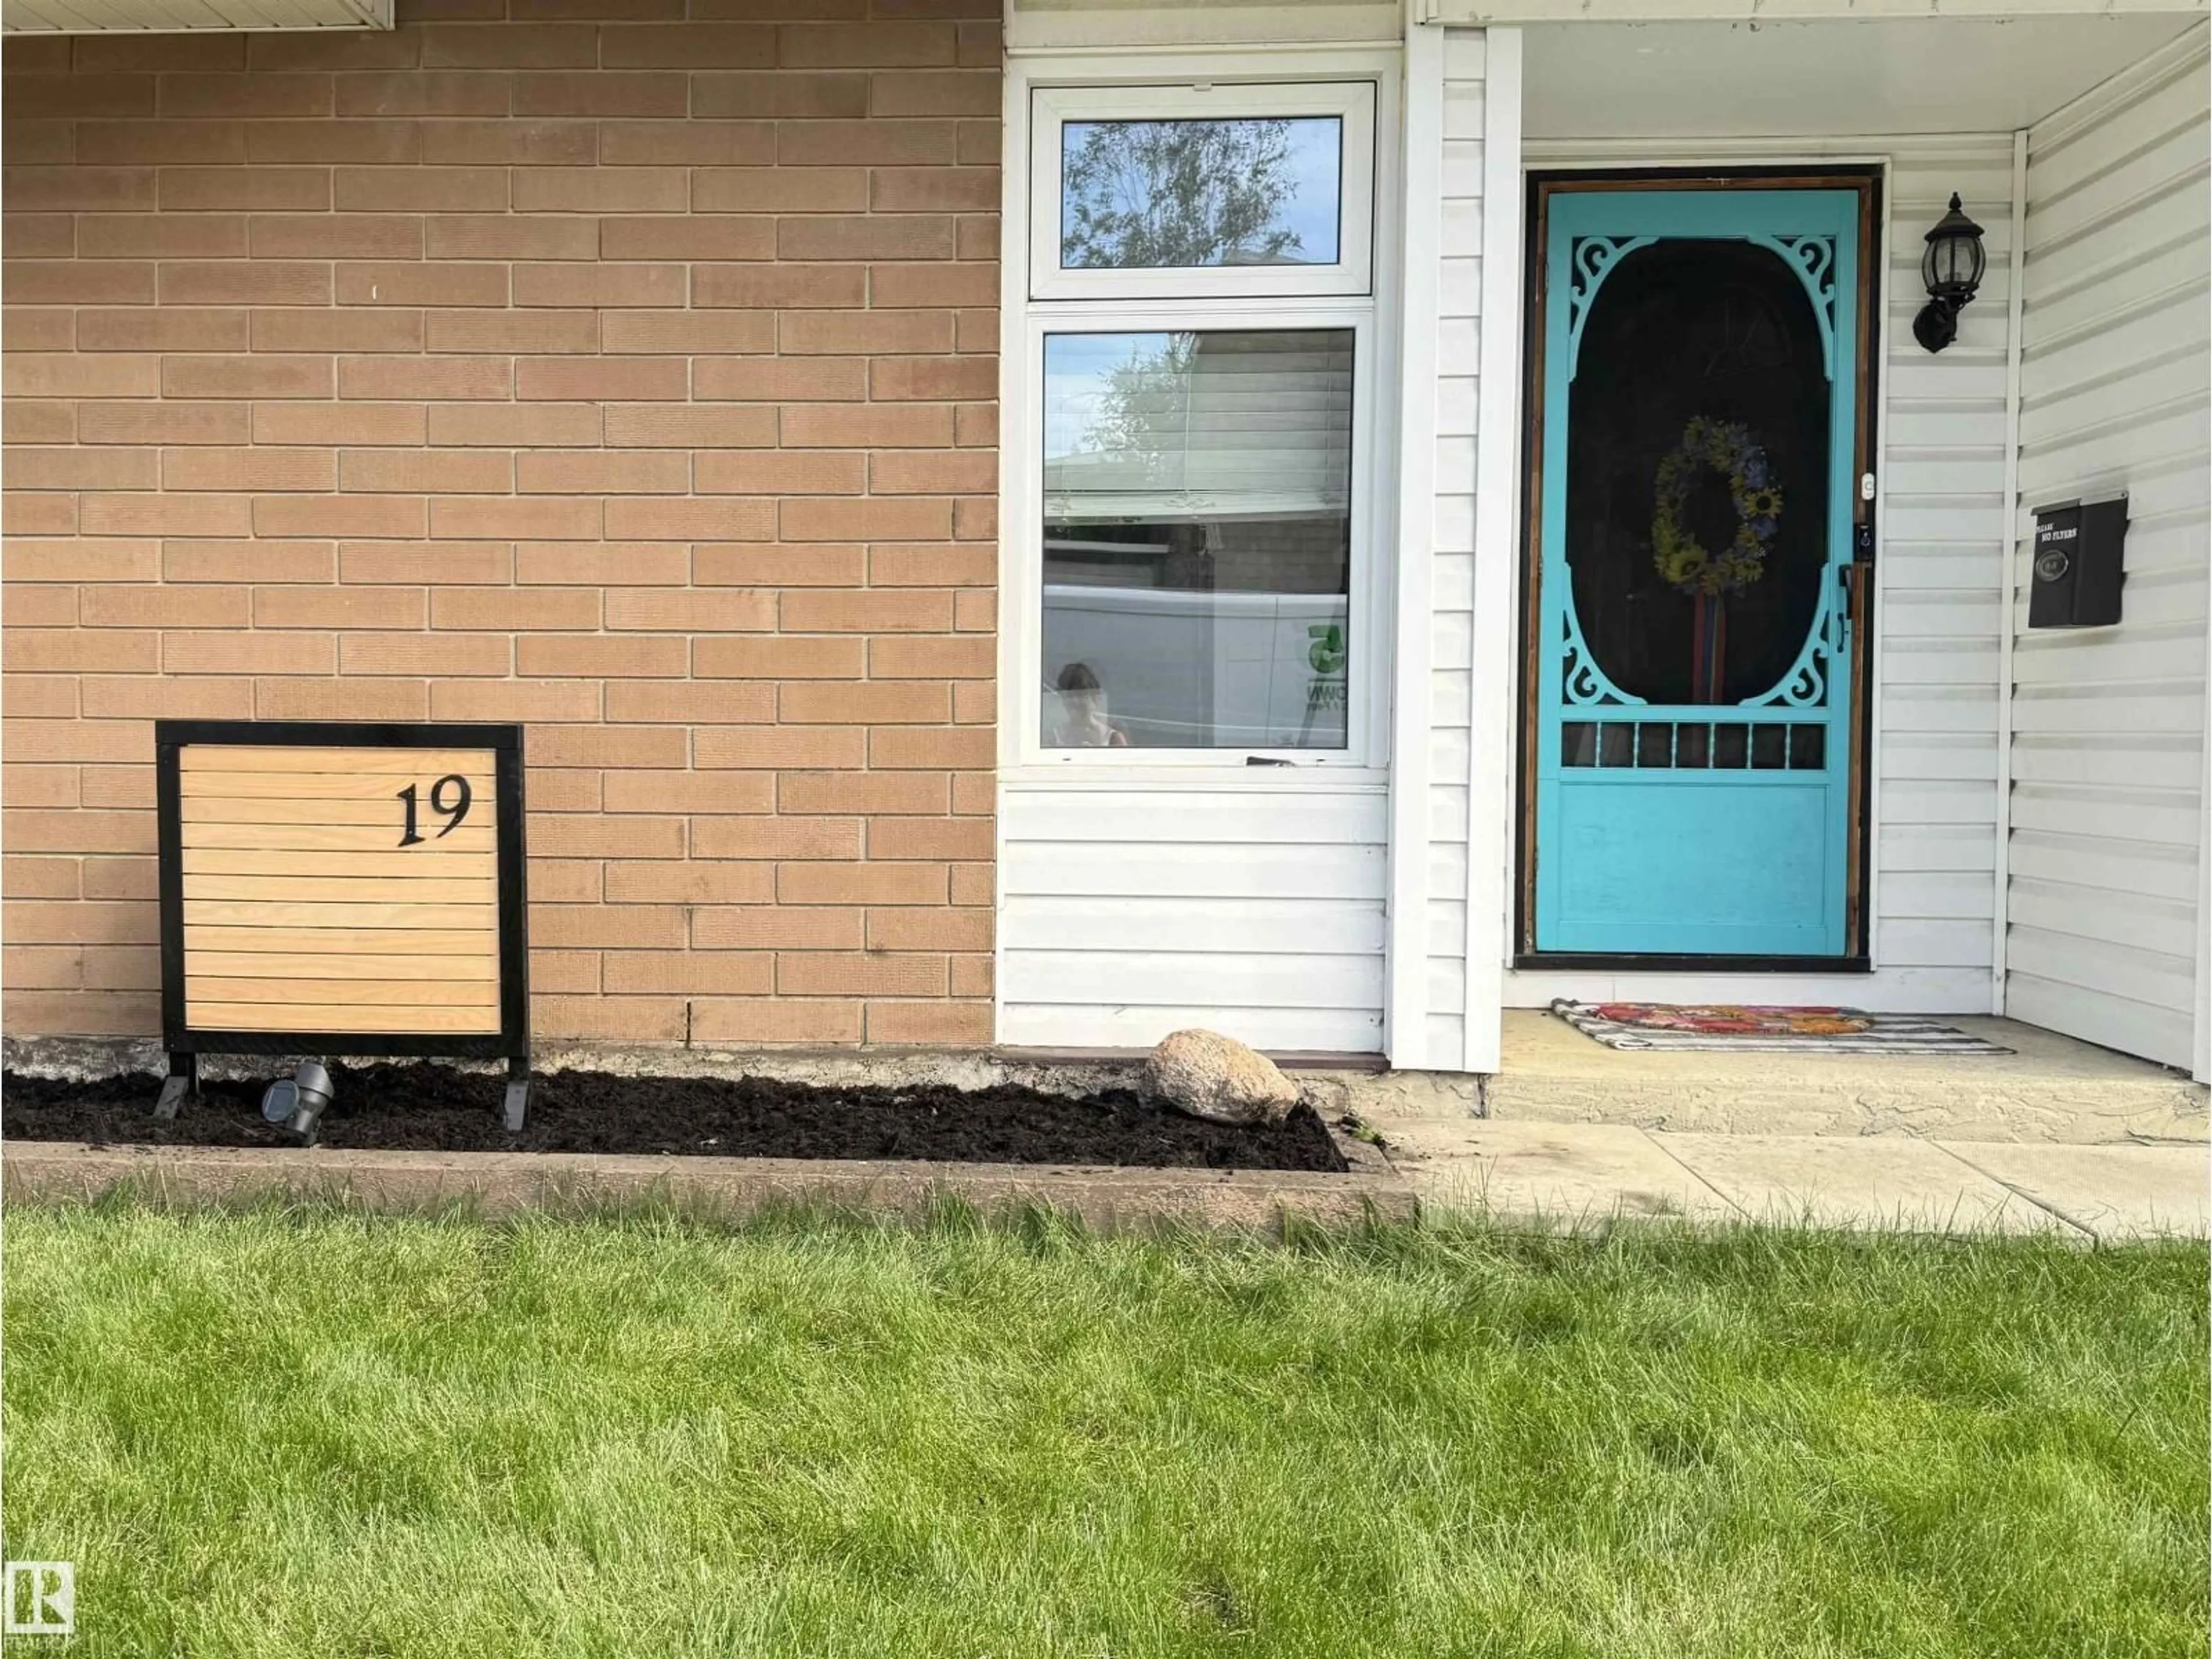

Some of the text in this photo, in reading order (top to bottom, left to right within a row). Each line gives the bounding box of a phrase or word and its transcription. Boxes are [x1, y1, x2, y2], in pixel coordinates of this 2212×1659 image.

[2042, 528, 2078, 543] NO FLYERS
[396, 774, 472, 847] 19
